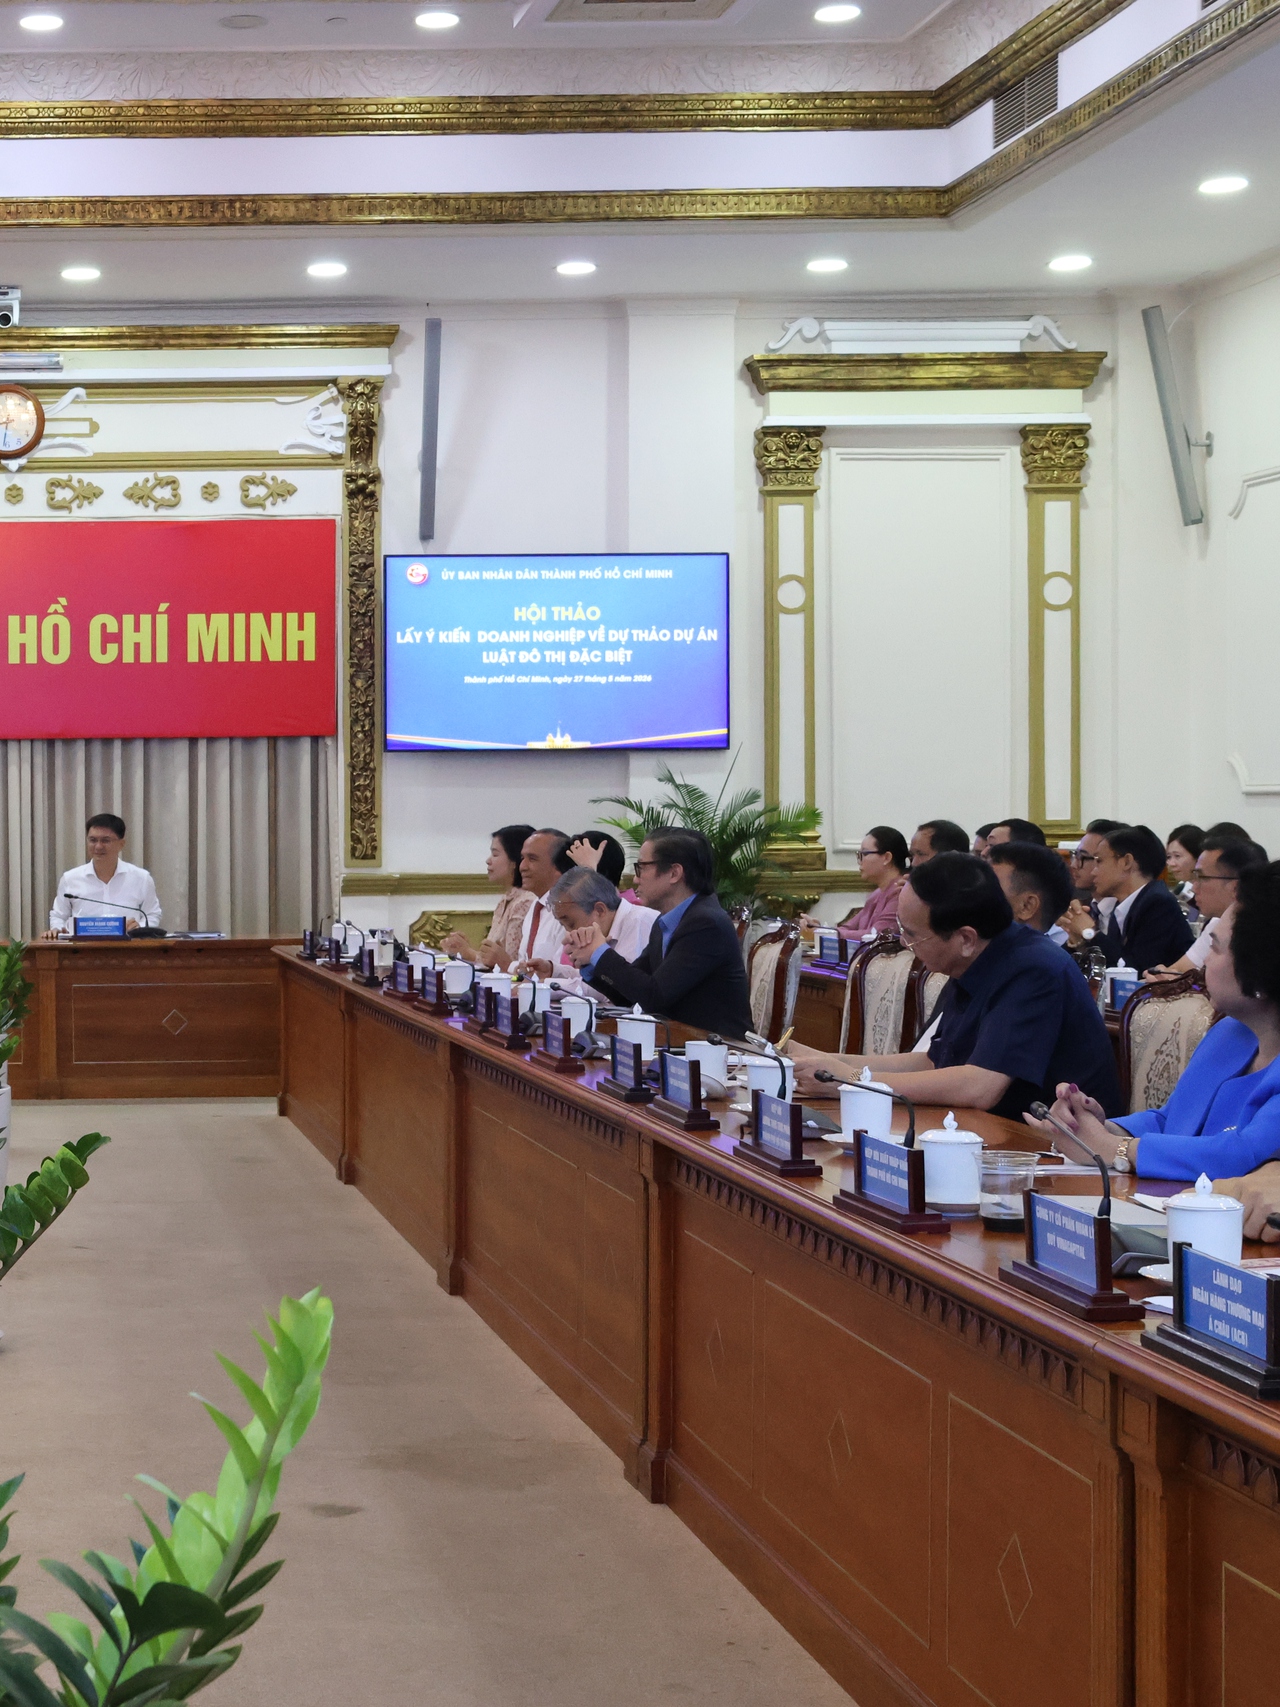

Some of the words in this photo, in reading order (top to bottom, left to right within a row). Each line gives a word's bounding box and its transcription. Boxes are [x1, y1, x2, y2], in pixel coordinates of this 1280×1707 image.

[442, 569, 455, 580] ỦY
[458, 571, 480, 580] BAN
[482, 569, 512, 579] NHÂN
[516, 568, 538, 579] DÂN
[541, 568, 576, 579] THÀNH
[579, 567, 602, 579] PHỐ
[604, 566, 620, 579] HỒ
[623, 568, 642, 579] CHÍ
[645, 570, 672, 578] MINH
[514, 603, 546, 625] HỘI
[552, 602, 601, 622] THẢO
[7, 597, 72, 664] HỒ
[89, 603, 170, 664] CHÍ
[187, 612, 317, 663] MINH
[397, 627, 422, 643] LẤY
[426, 628, 435, 643] Ý
[439, 626, 470, 643] KIẾN
[478, 631, 530, 642] DOANH
[533, 627, 586, 645] NGHIỆP
[588, 624, 605, 642] VỀ
[608, 628, 629, 644] DỰ
[631, 626, 671, 641] THẢO
[674, 628, 694, 644] DỰ
[697, 626, 717, 641] ÁN
[483, 648, 516, 666] LUẬT
[518, 648, 541, 663] ĐÔ
[544, 651, 566, 665] THỊ
[569, 648, 601, 665] ĐẶC
[605, 647, 632, 665] BIỆT
